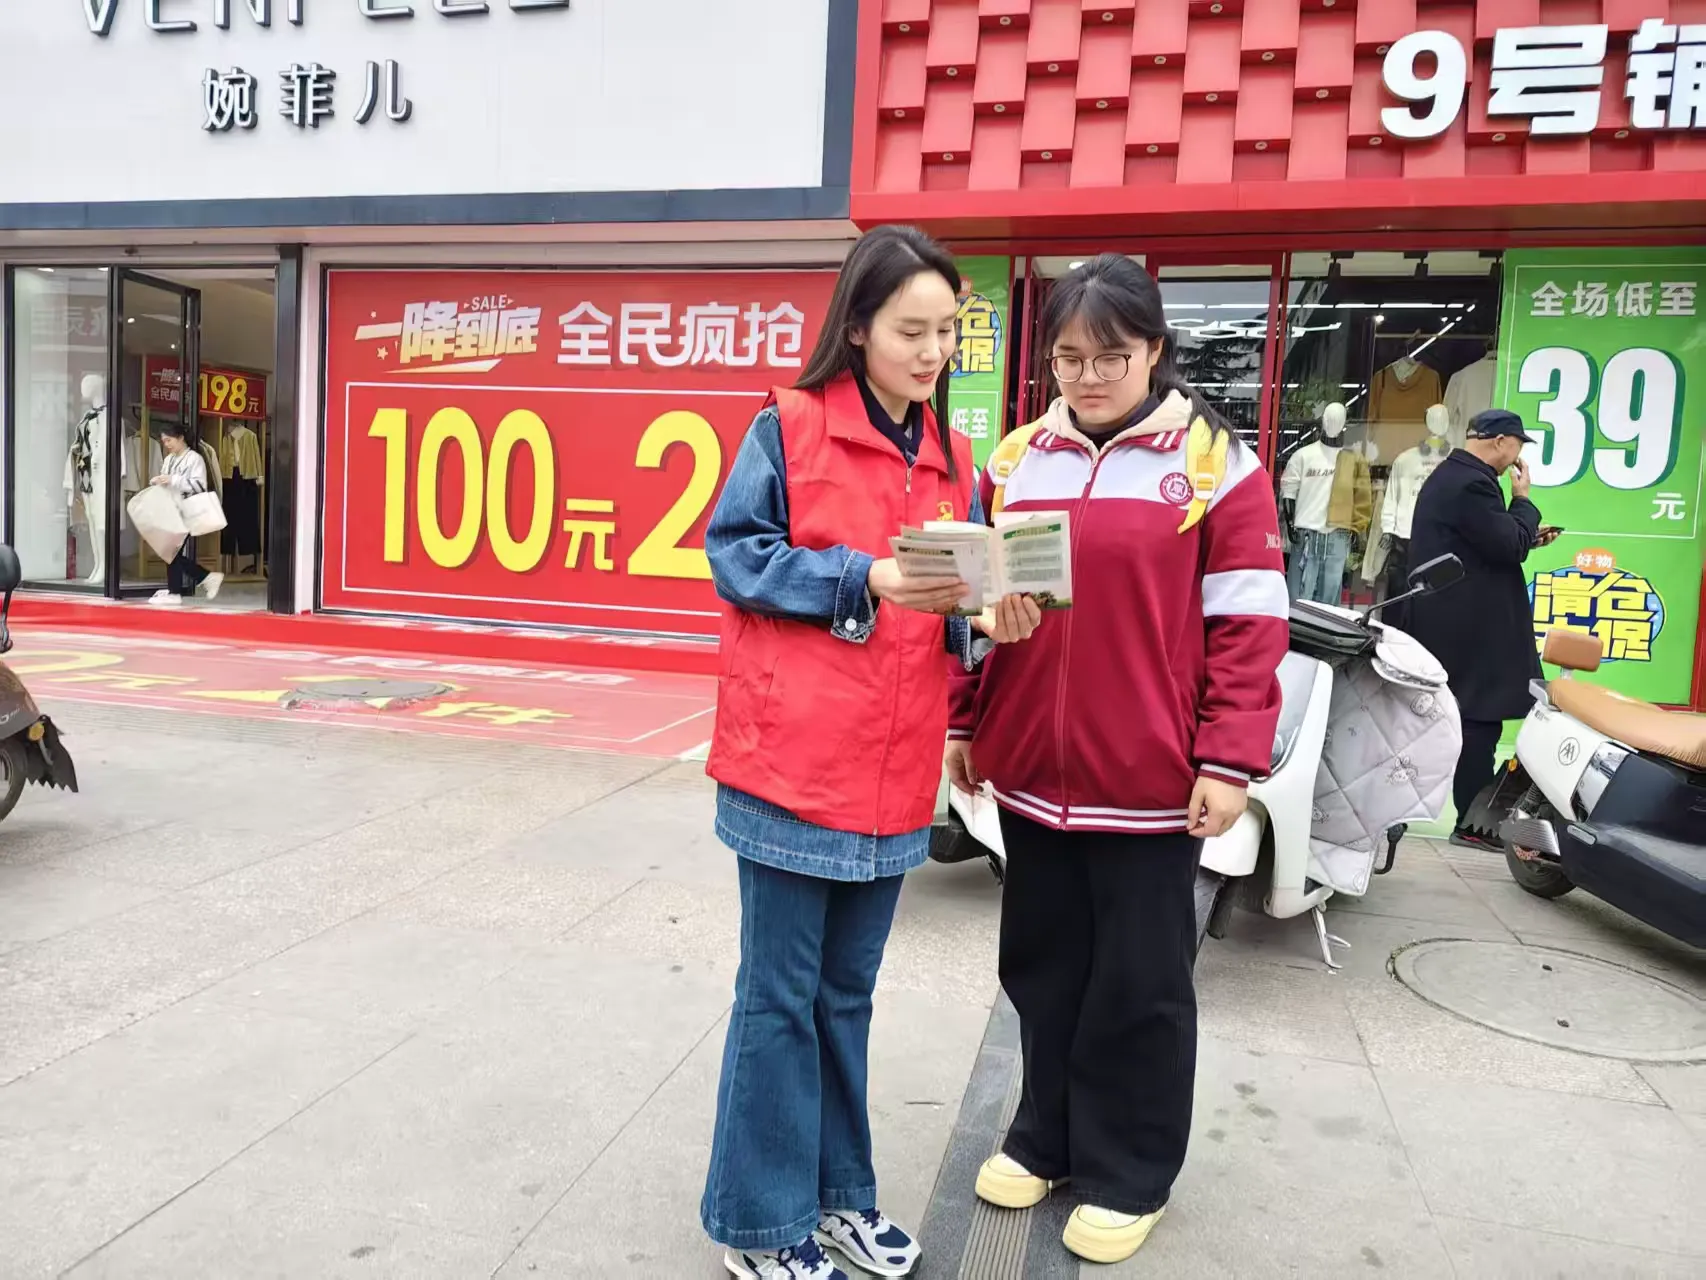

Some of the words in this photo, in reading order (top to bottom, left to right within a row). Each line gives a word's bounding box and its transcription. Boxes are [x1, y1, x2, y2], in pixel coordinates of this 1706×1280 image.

[201, 59, 412, 132] 婉菲儿
[472, 294, 508, 311] SALE
[1530, 281, 1698, 318] 全场低至
[355, 300, 542, 364] 一降到底
[557, 301, 805, 368] 全民疯抢
[1518, 346, 1685, 490] 39
[1651, 492, 1686, 520] 元
[1576, 554, 1614, 569] 好物
[1534, 572, 1653, 622] 清仓
